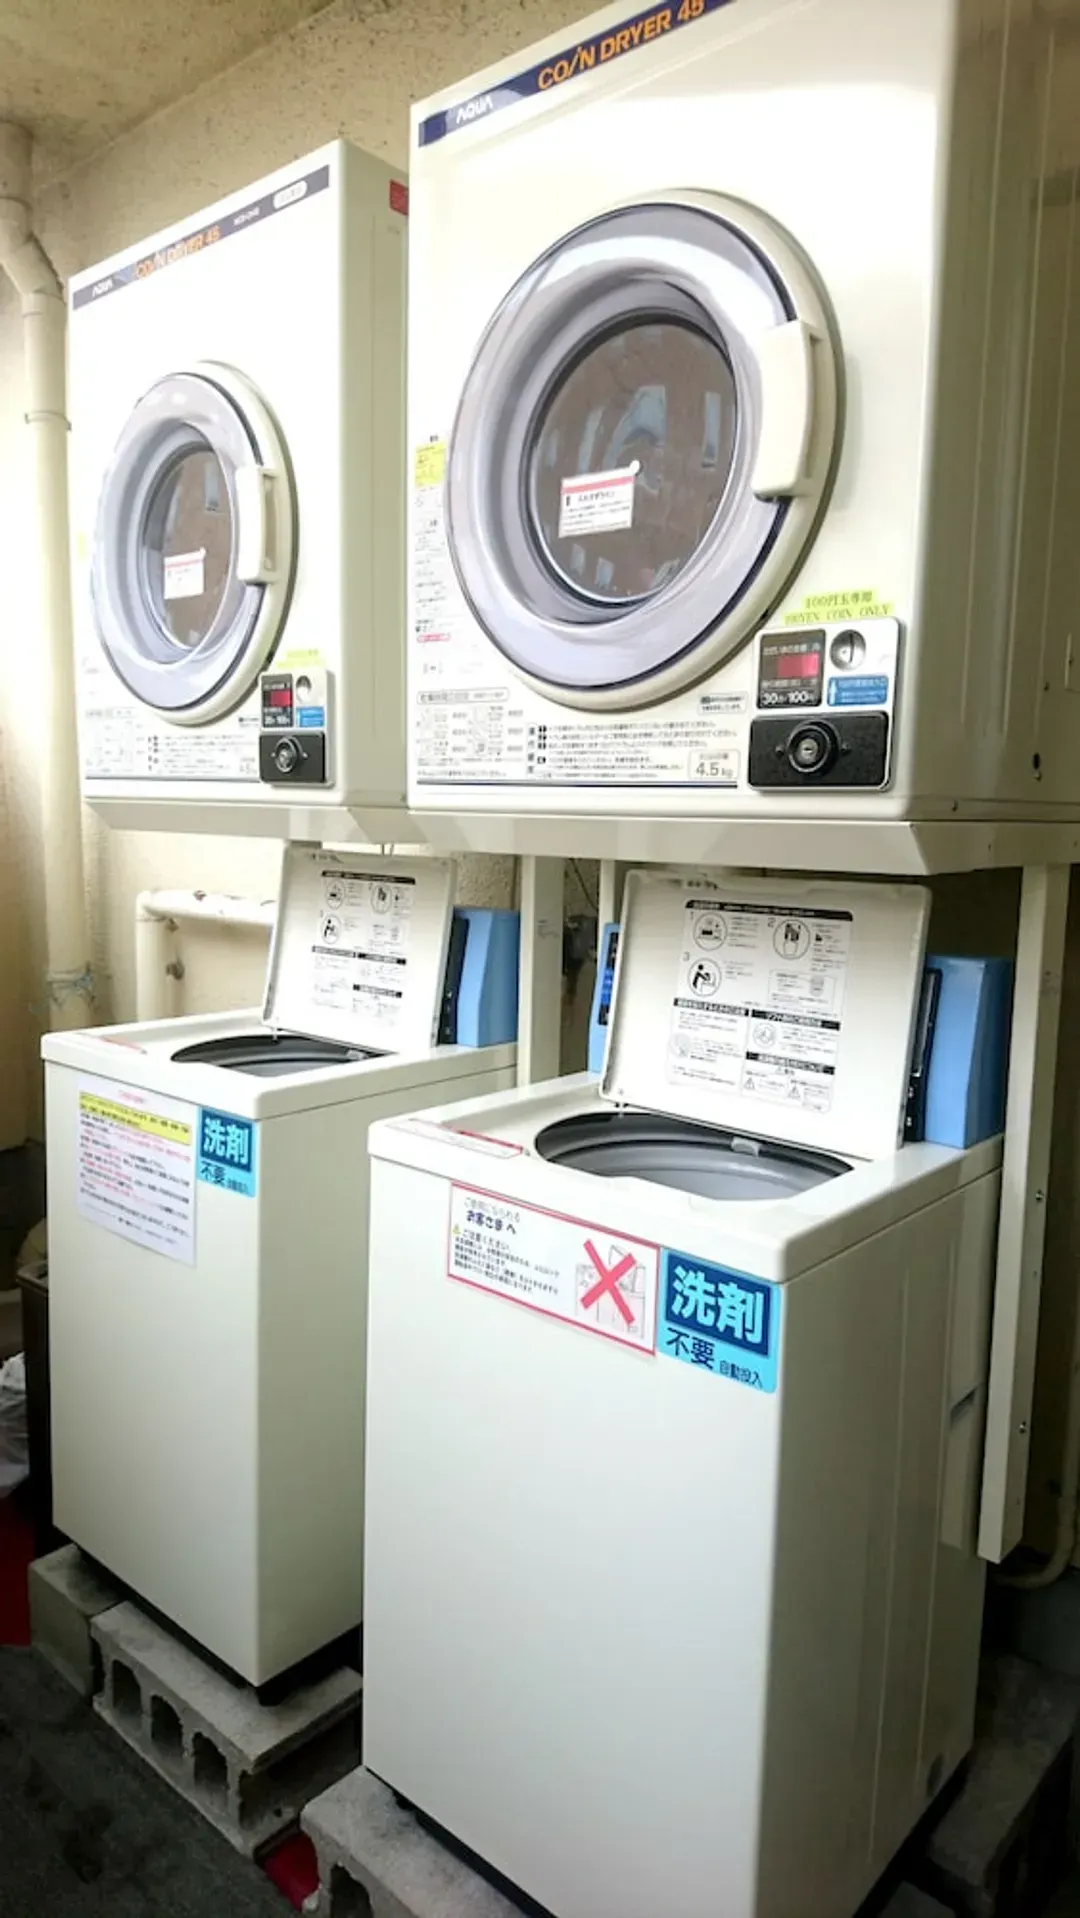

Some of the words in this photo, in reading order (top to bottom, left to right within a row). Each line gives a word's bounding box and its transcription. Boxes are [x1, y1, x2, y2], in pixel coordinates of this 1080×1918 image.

[456, 95, 493, 124] AQUA
[600, 9, 672, 61] DRYER
[677, 0, 706, 21] 45
[695, 761, 720, 777] 4.5
[203, 1116, 250, 1165] 洗剤
[200, 1162, 226, 1185] 不要
[670, 1264, 765, 1345] 洗剤
[666, 1327, 715, 1371] 不要
[719, 1360, 764, 1389] 自動投入
